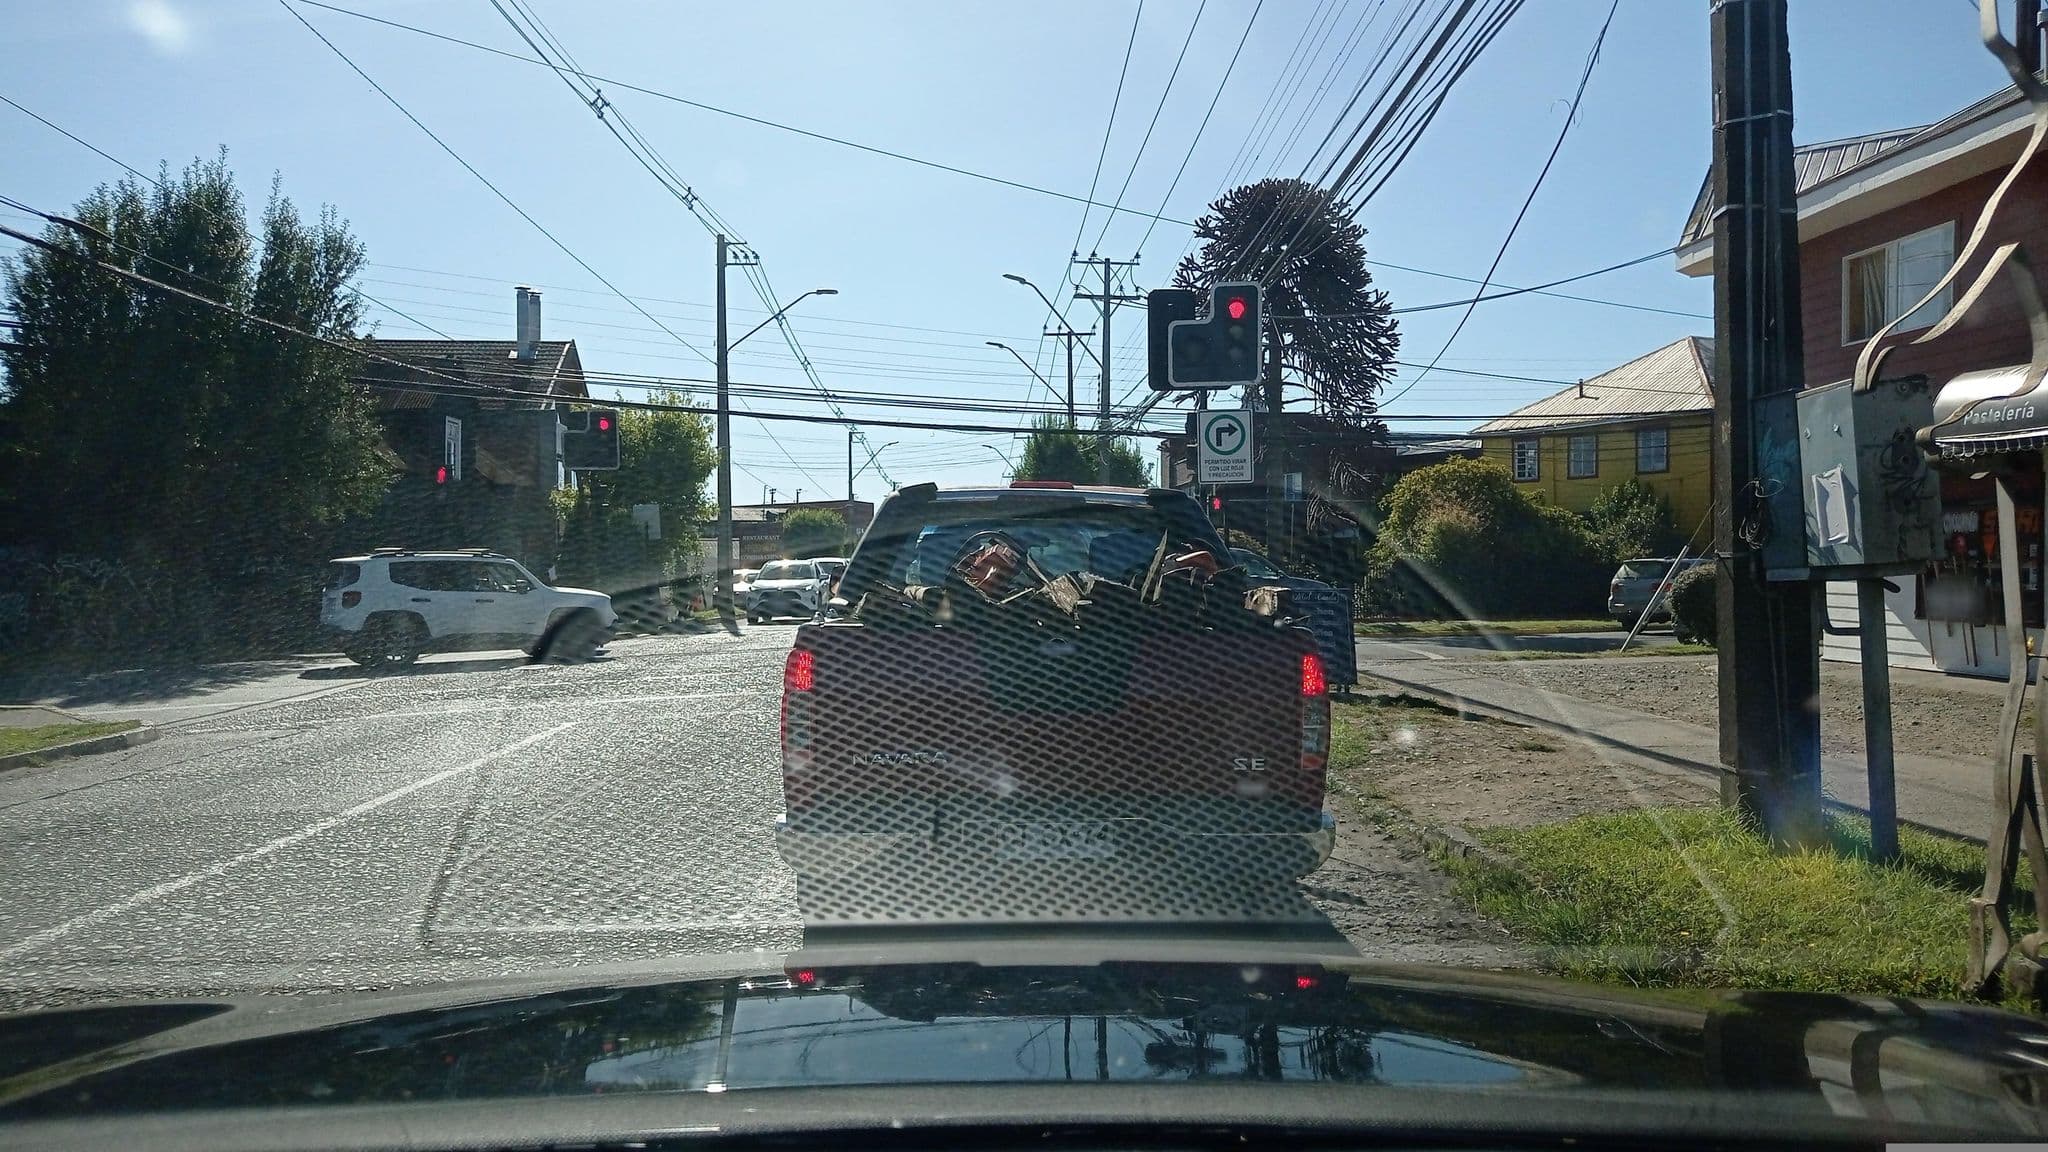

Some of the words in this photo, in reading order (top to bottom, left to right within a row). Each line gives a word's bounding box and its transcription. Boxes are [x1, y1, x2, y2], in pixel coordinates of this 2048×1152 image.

[1963, 401, 2035, 425] Pastelería
[852, 751, 947, 765] NAVARA
[1233, 758, 1265, 771] SE
